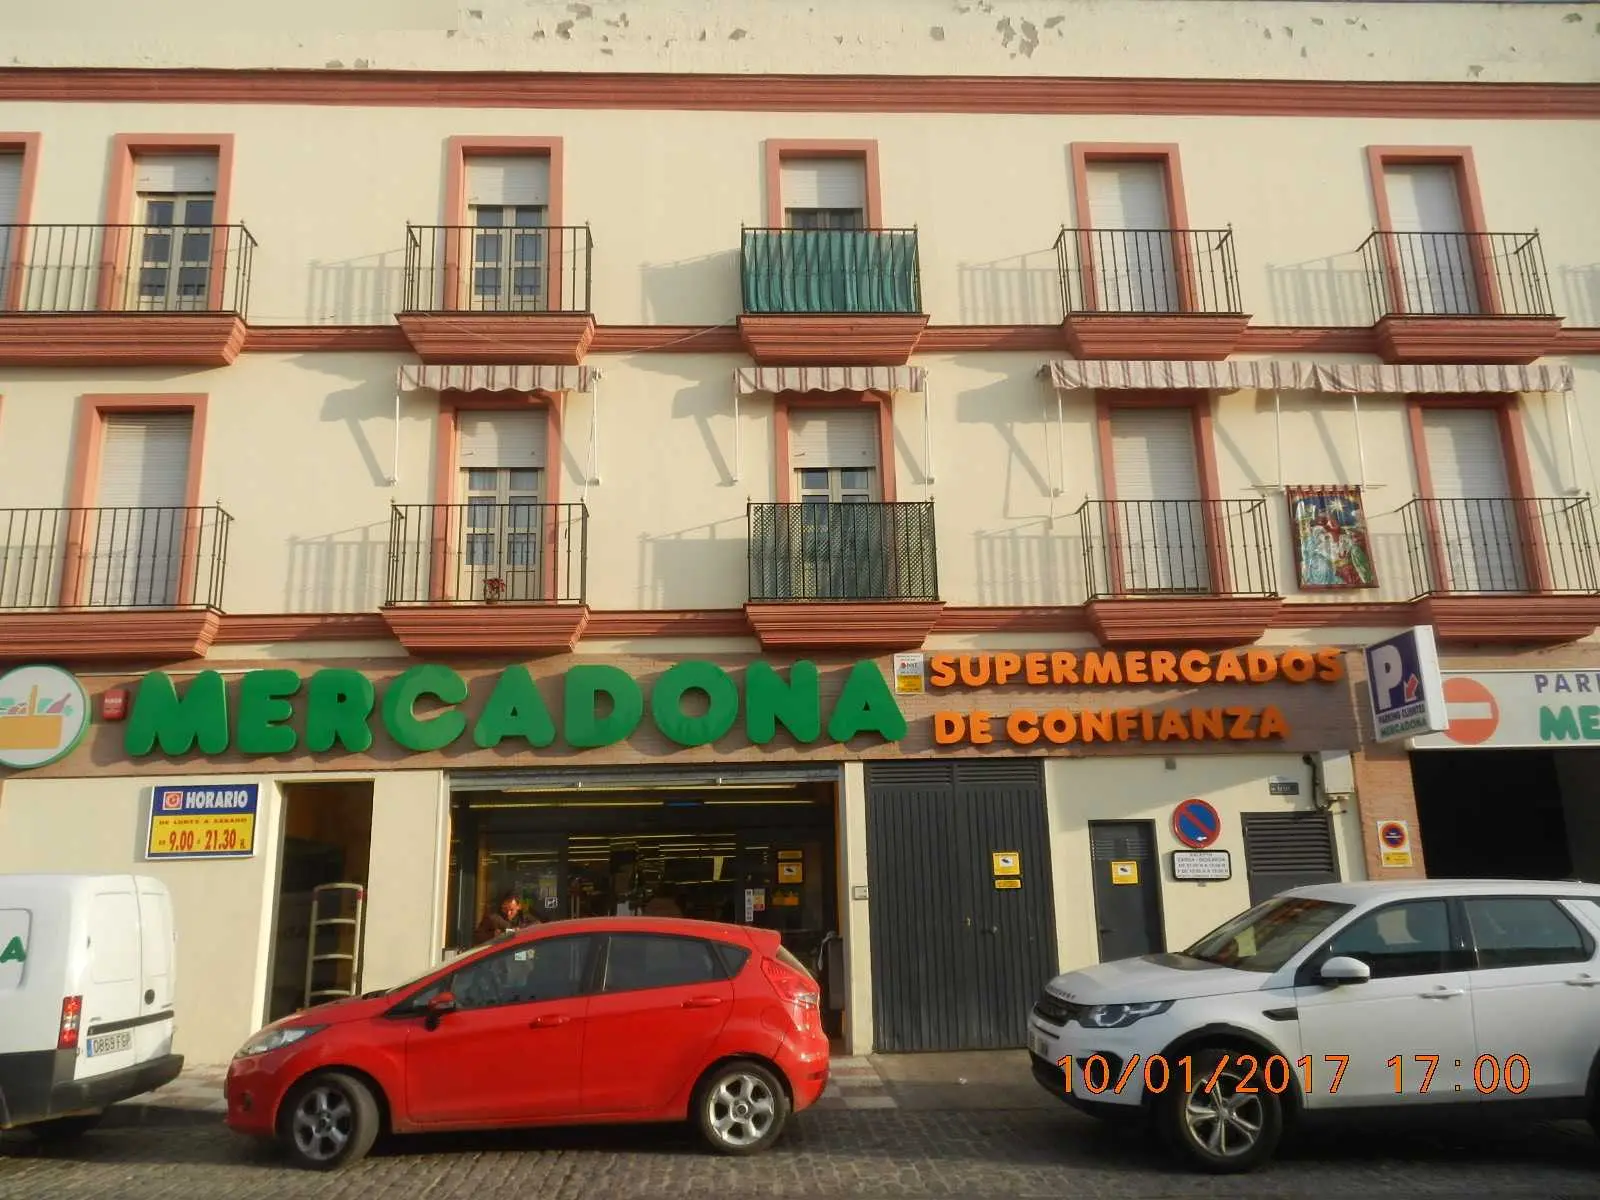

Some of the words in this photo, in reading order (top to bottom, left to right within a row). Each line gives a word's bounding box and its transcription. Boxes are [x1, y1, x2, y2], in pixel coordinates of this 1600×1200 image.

[929, 649, 1343, 687] SUPERMERCADOS
[1371, 644, 1403, 711] P
[1534, 673, 1600, 693] PAR
[124, 659, 908, 757] MERCADONA
[934, 711, 994, 745] DE
[1005, 706, 1291, 745] CONFIANZA
[185, 790, 248, 809] HORARIO
[169, 830, 194, 851] 9.00
[204, 828, 236, 850] 21.30
[0, 935, 26, 963] A
